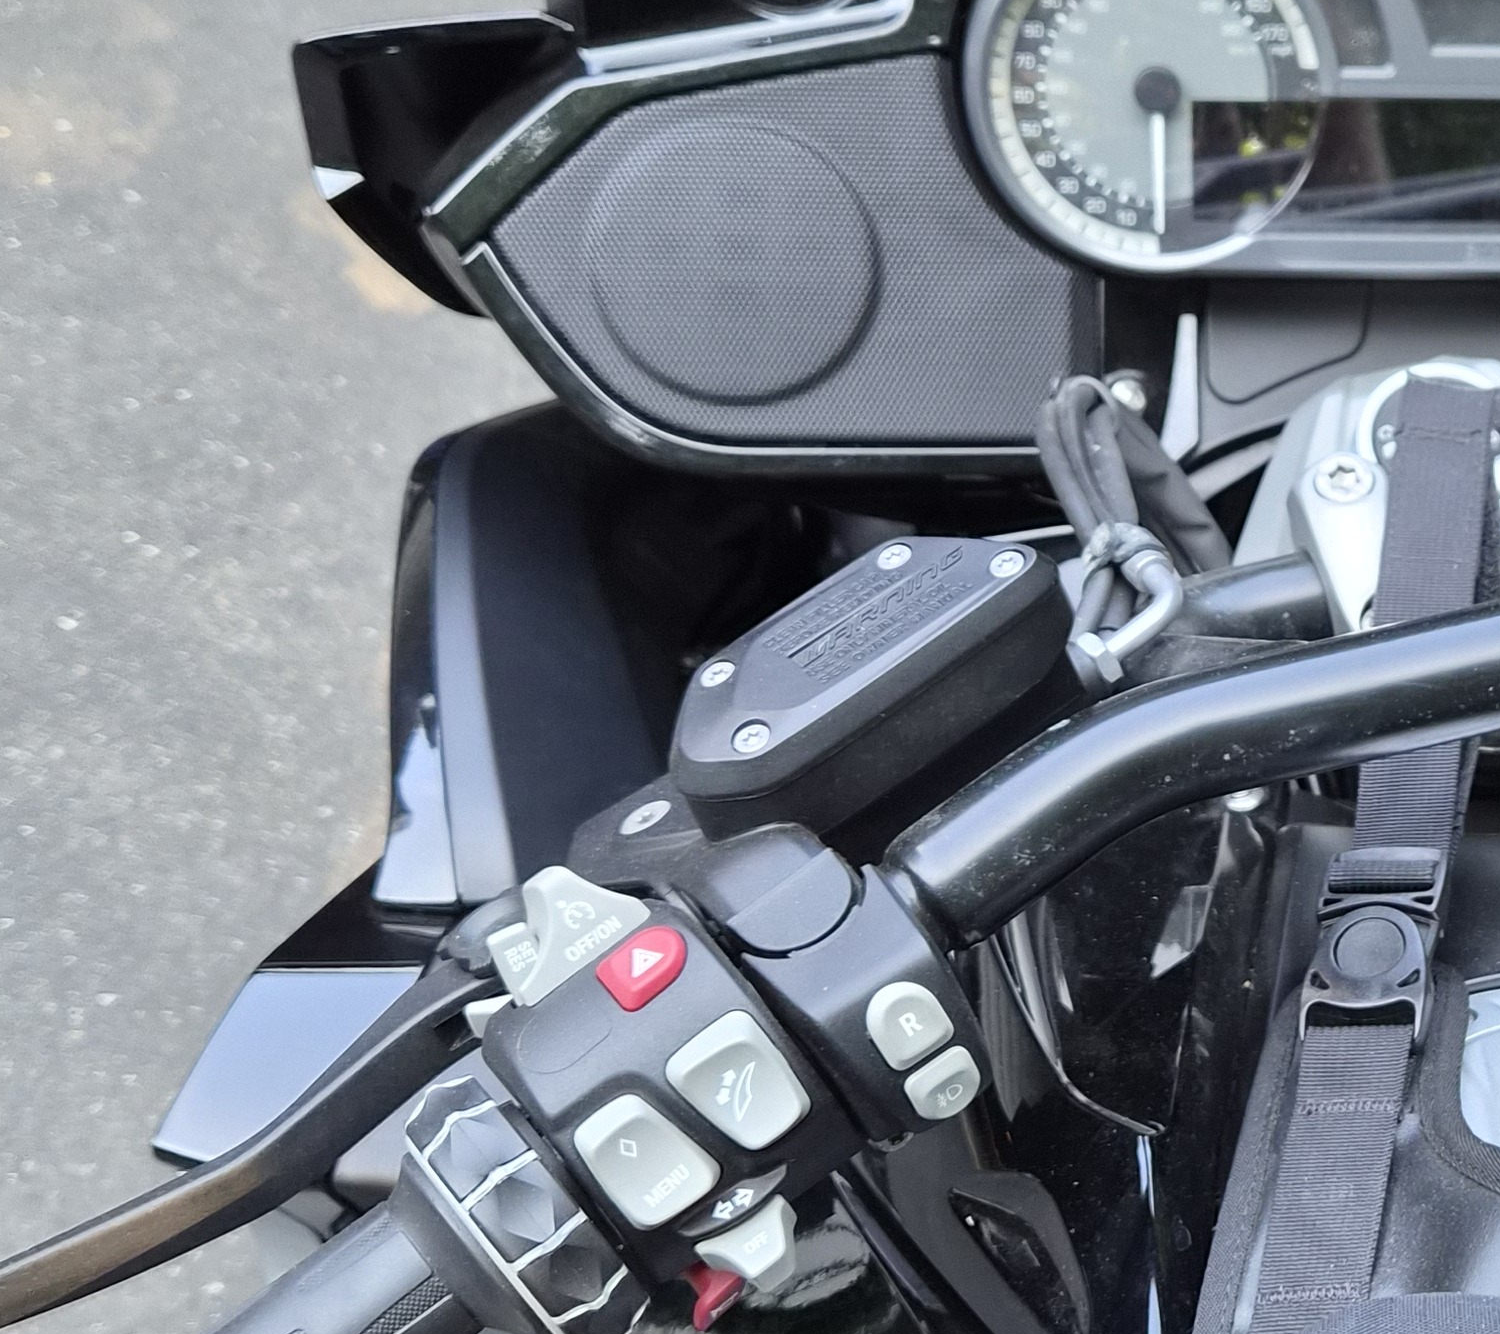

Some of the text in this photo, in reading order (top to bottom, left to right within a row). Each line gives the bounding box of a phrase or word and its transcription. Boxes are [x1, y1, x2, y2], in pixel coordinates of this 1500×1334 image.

[801, 545, 963, 668] WARNING
[564, 915, 622, 962] OFF/ON
[898, 1012, 924, 1037] R
[643, 1163, 690, 1208] MENU
[743, 1230, 769, 1255] OFF
